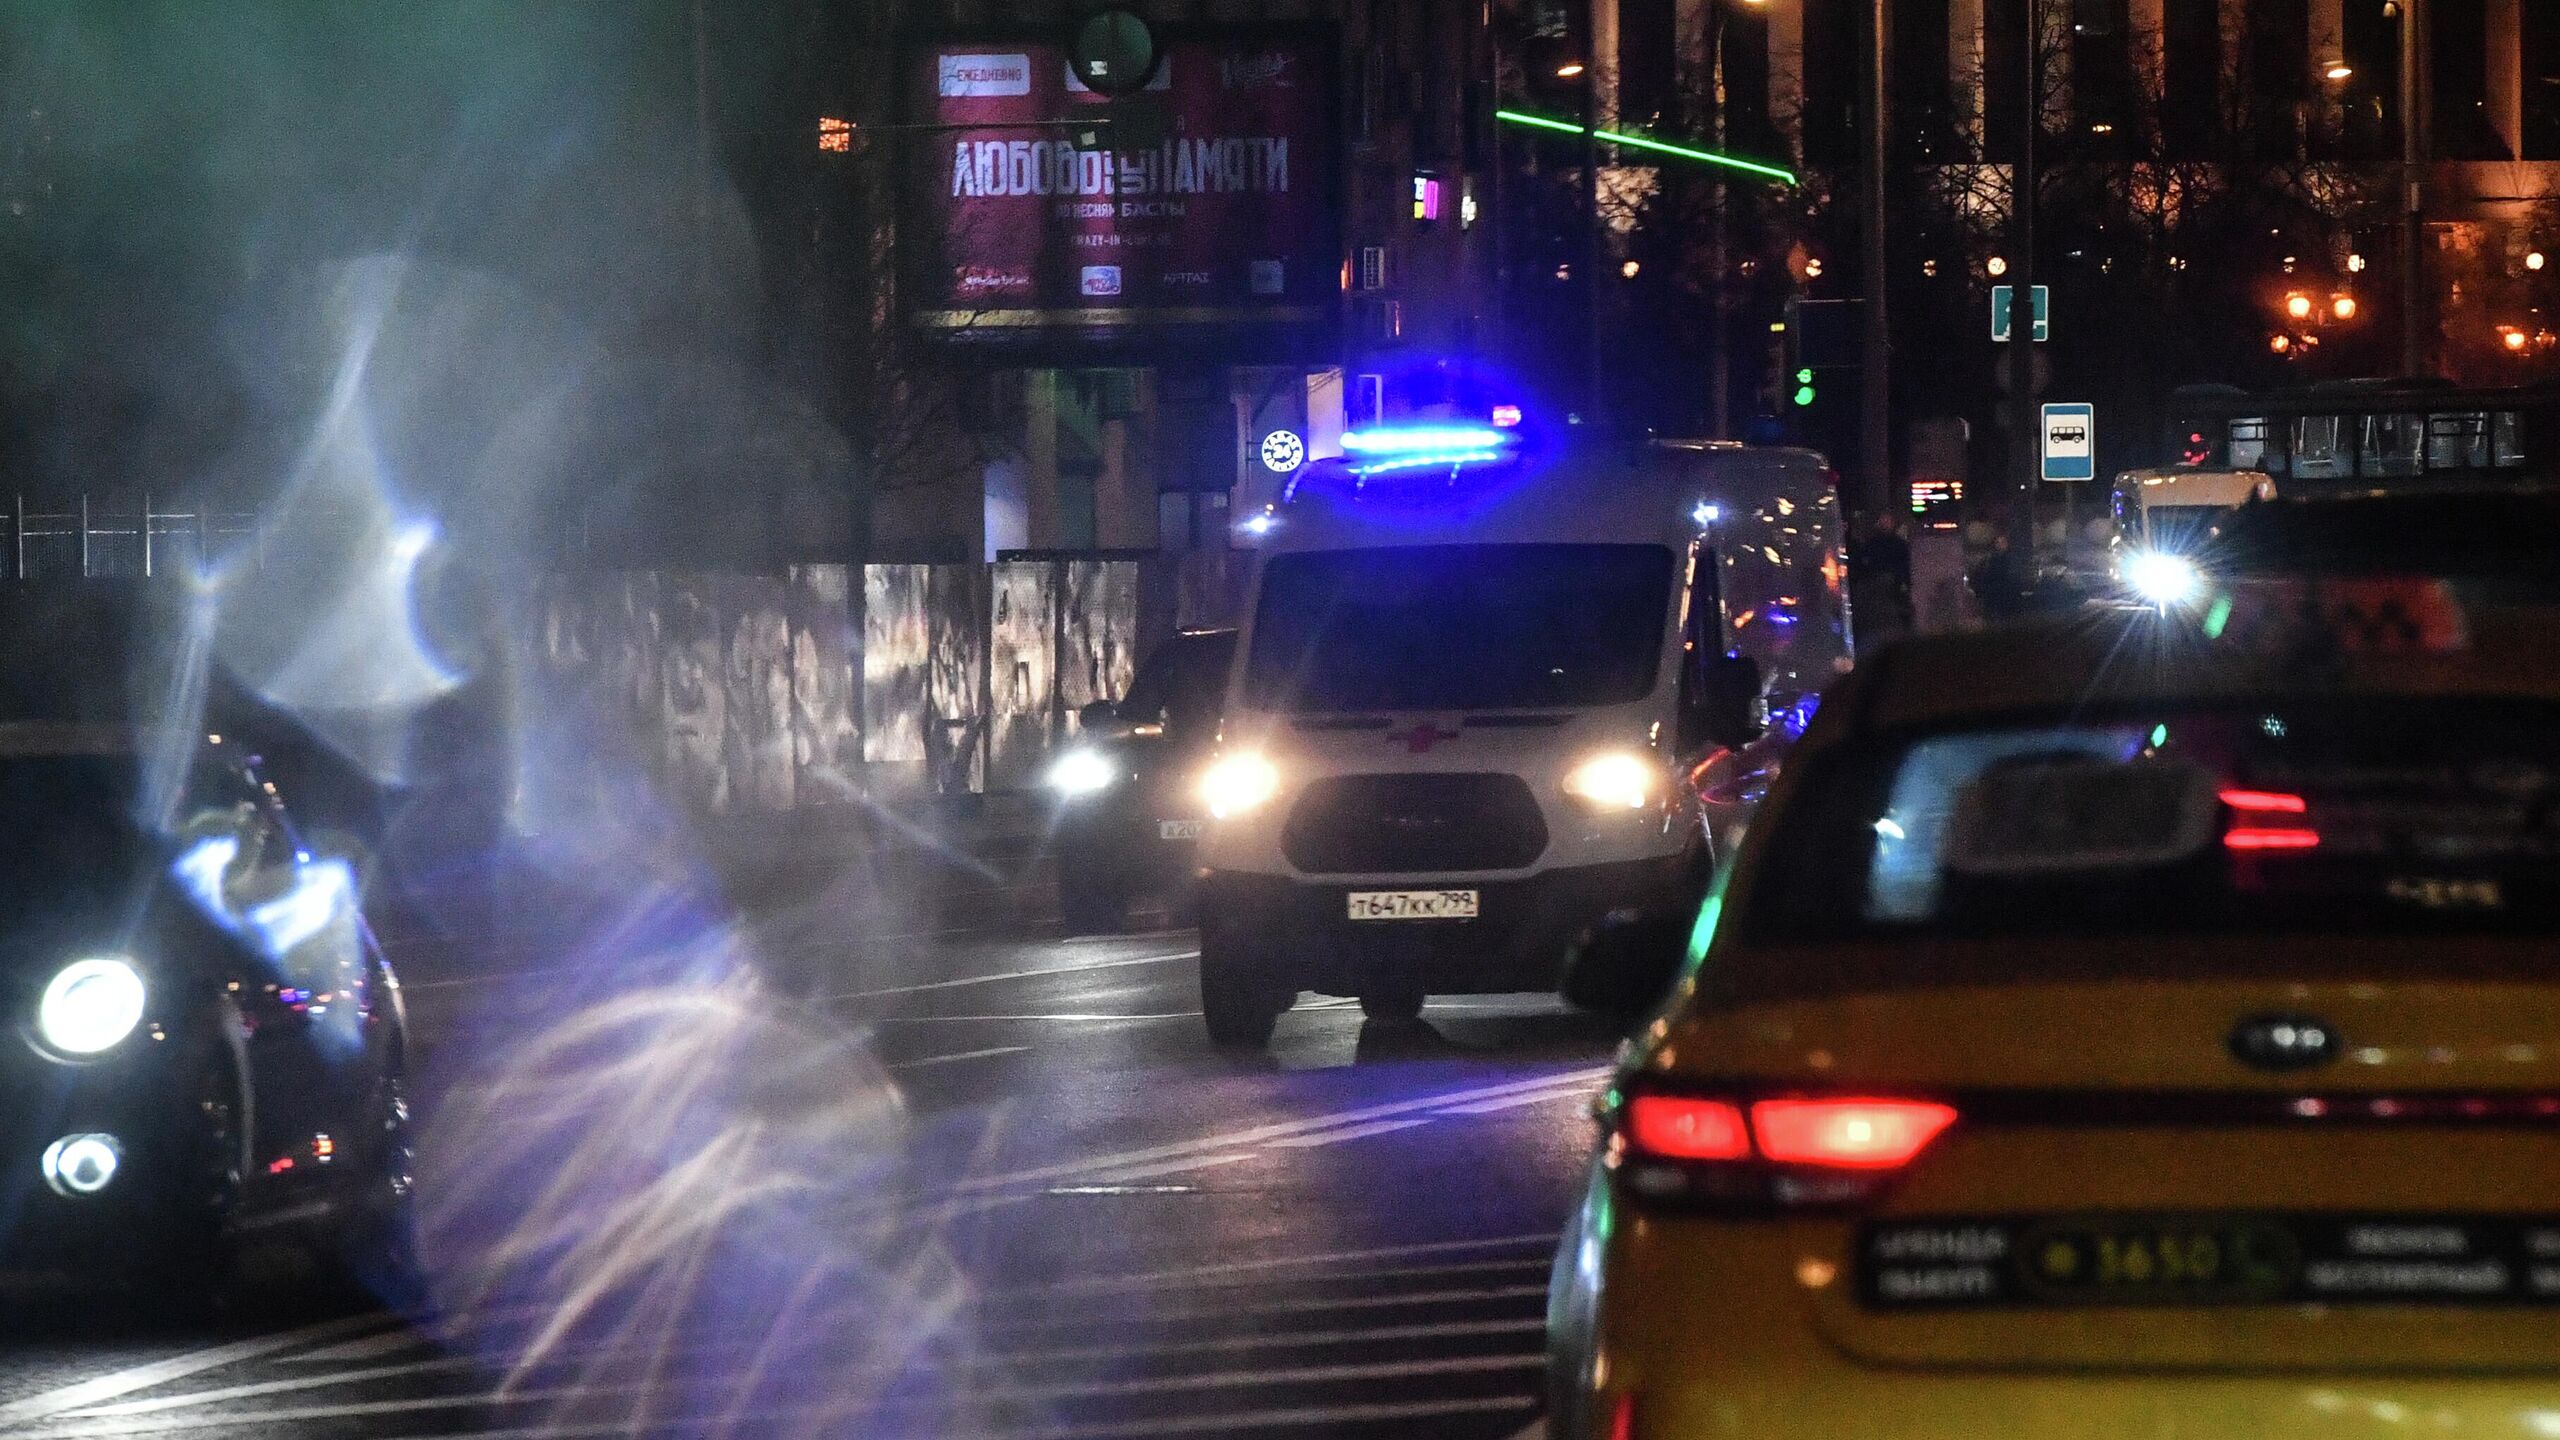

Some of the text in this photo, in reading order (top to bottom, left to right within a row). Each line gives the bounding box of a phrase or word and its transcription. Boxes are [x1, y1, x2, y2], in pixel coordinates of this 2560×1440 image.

[957, 69, 1021, 81] ЕЖЕДНЕВНО
[1151, 137, 1288, 193] ПАМЯТИ
[1121, 202, 1186, 217] БАСТЫ
